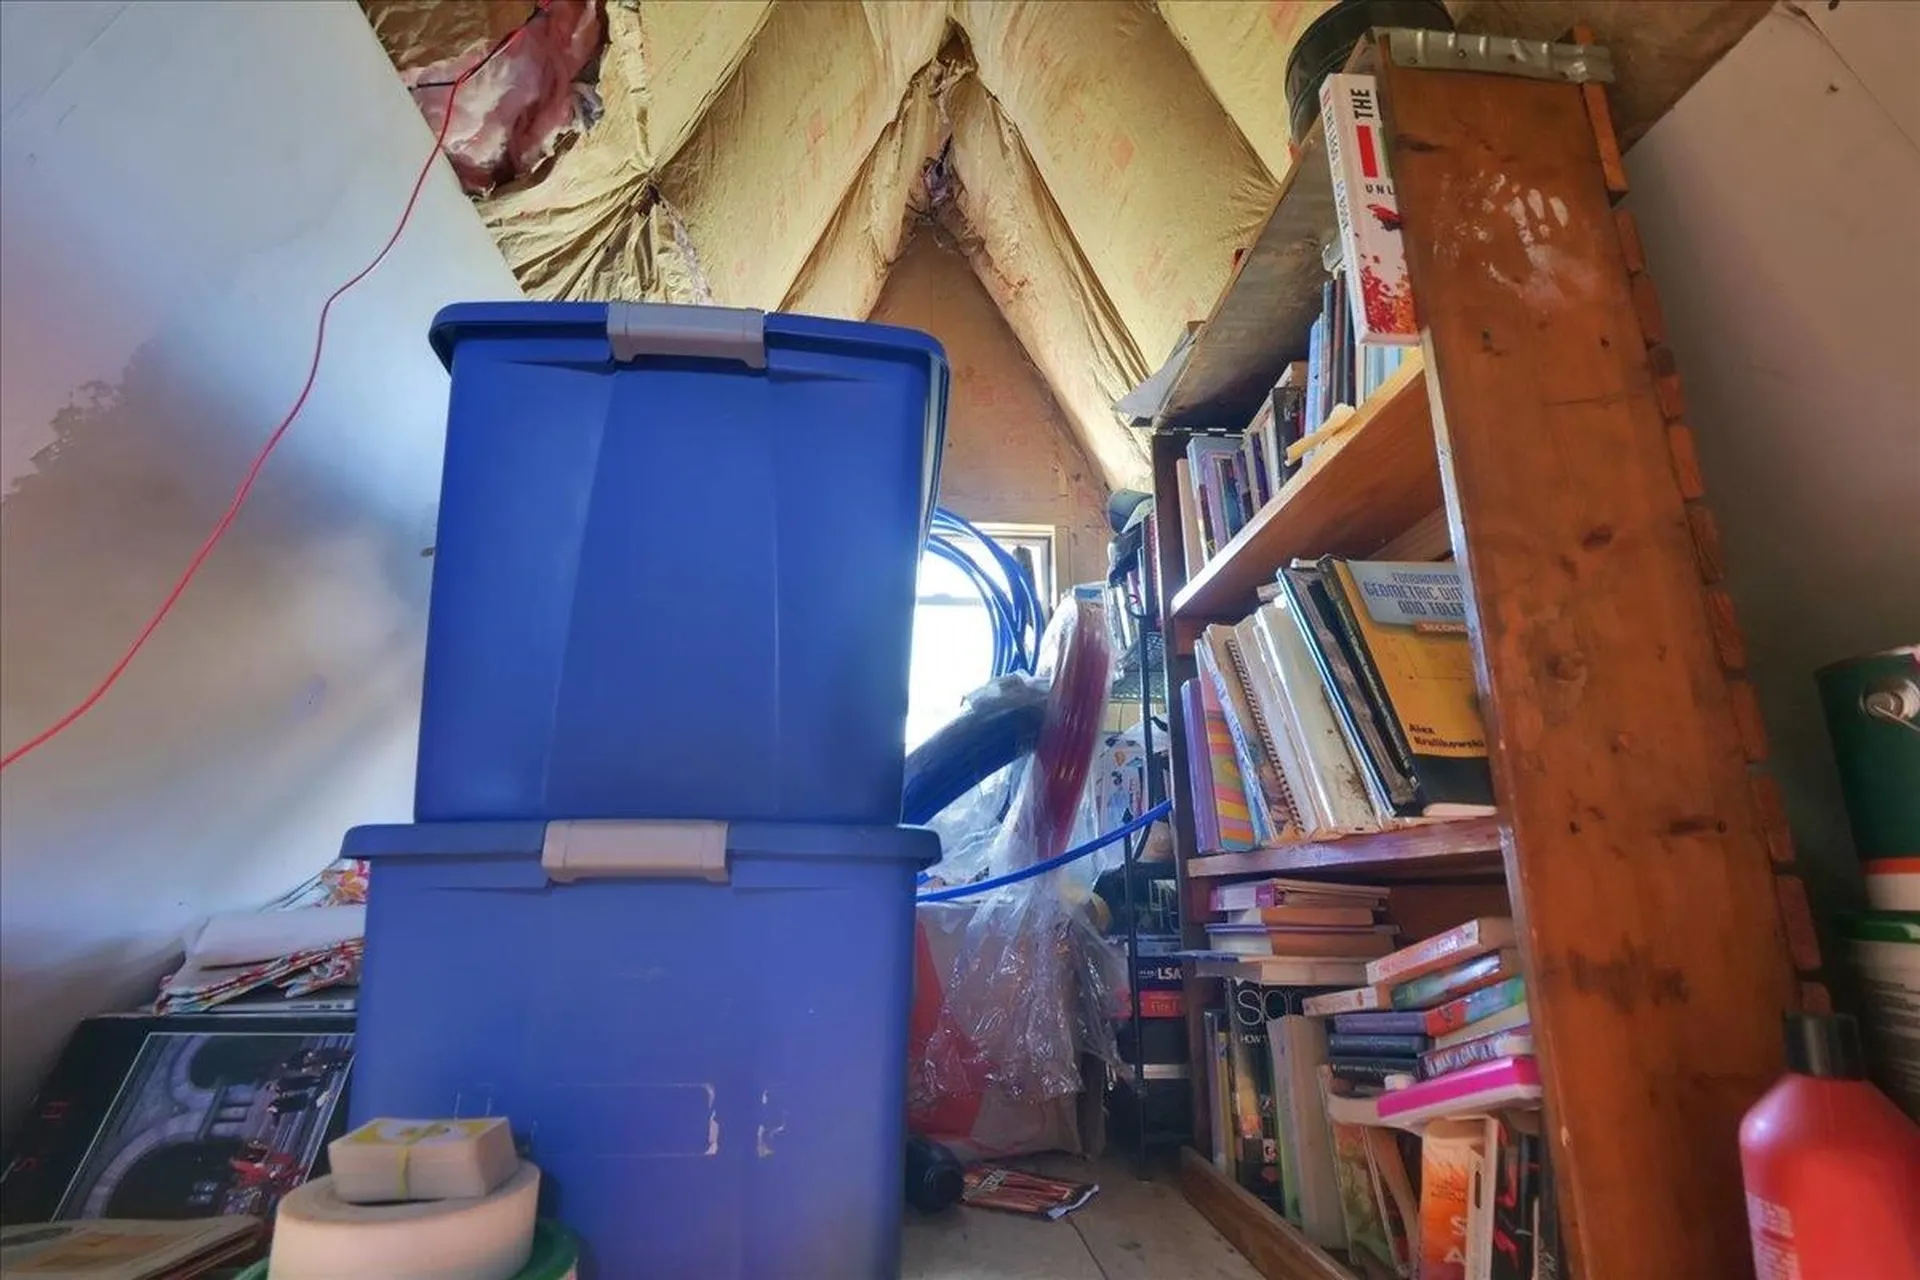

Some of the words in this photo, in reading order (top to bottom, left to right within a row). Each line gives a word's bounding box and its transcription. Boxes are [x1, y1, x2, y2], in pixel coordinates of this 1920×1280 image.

[1350, 88, 1374, 119] THE
[1362, 580, 1438, 600] GEOMETRIC
[1409, 723, 1435, 734] Alex
